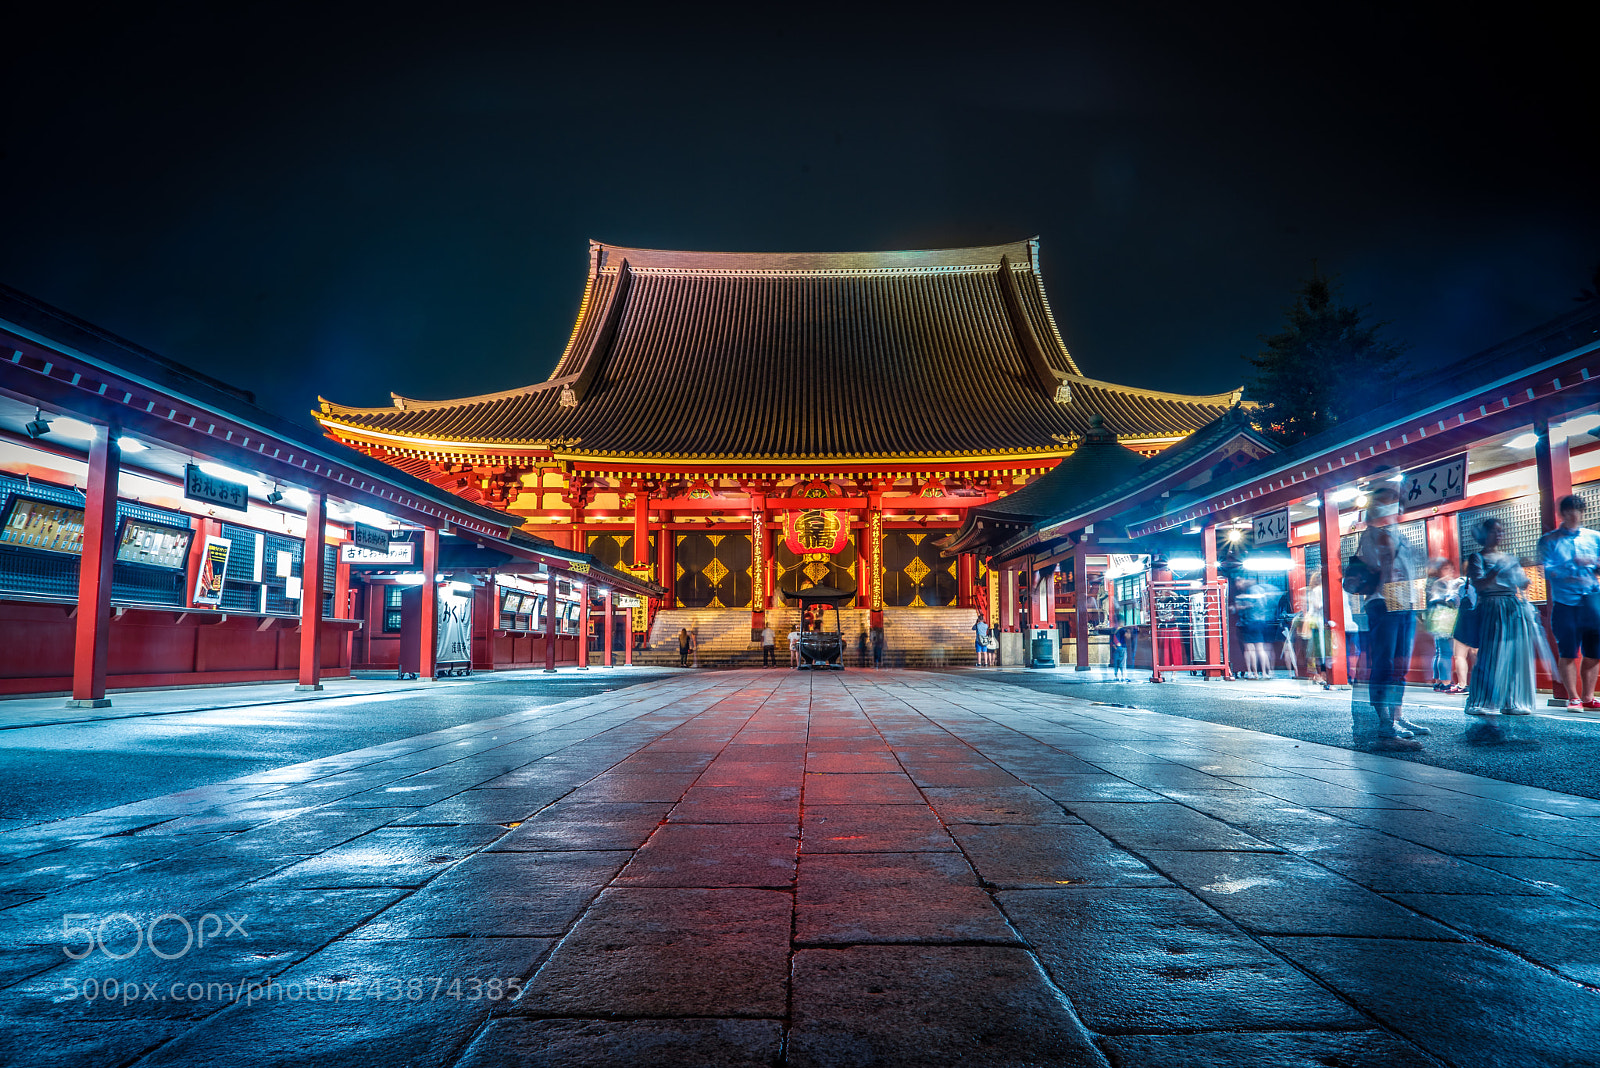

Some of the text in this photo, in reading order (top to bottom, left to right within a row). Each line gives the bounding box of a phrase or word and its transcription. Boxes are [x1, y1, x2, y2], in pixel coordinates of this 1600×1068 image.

[191, 474, 241, 504] お札お守
[1408, 464, 1461, 501] みくじ
[1257, 515, 1285, 539] みくじ
